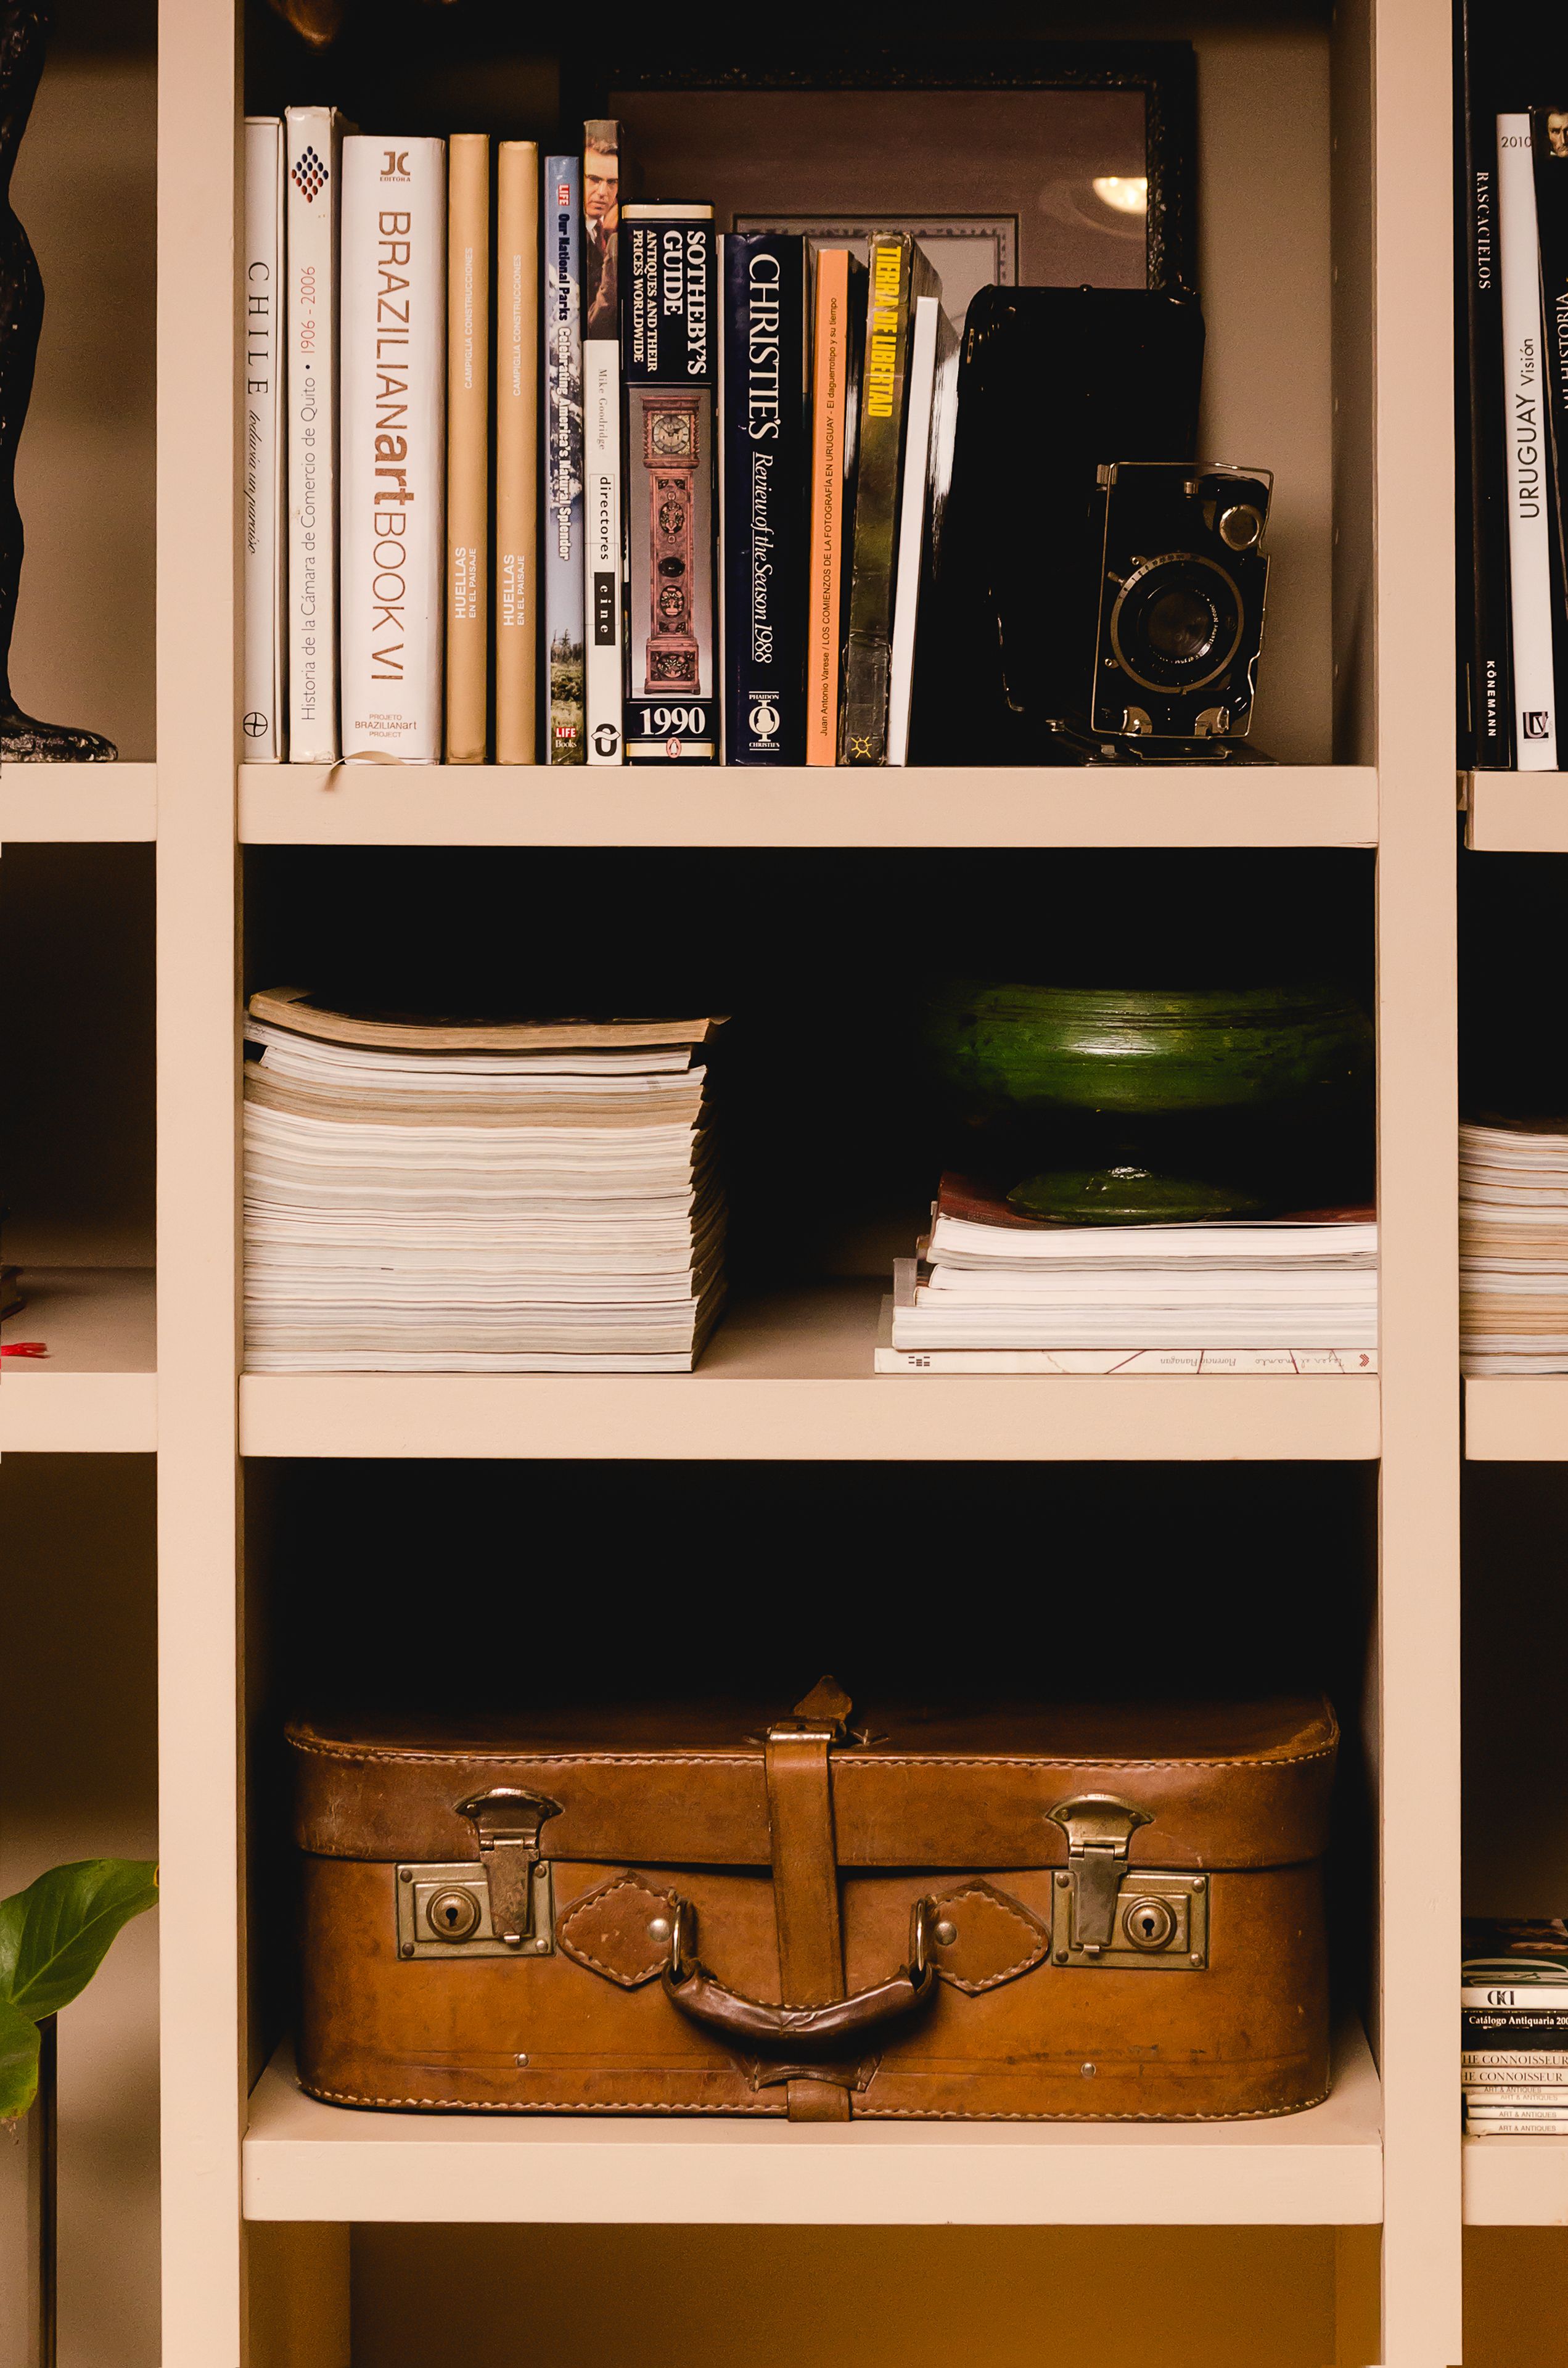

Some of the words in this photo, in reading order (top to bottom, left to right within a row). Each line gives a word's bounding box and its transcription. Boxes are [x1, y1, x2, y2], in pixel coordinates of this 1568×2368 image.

[1501, 137, 1531, 147] 2010
[559, 185, 570, 206] LIFE
[559, 213, 570, 236] Our
[1477, 172, 1490, 289] RASCACIELOS
[559, 237, 570, 284] National
[633, 230, 642, 276] PRICES
[644, 229, 657, 297] ANTIQUES
[301, 267, 316, 304] 2006
[465, 247, 473, 334] CONSTRUCCIONES
[664, 230, 683, 316] GUIDE
[874, 246, 901, 307] TIERRA
[559, 287, 570, 321] Parks
[633, 279, 642, 362] WORLDWIDE
[647, 298, 658, 329] AND
[687, 231, 706, 374] SOTHEBY'S
[829, 297, 837, 325] tiempo
[248, 262, 269, 395] CHILE
[301, 321, 316, 353] 1906
[830, 327, 836, 337] su
[872, 311, 898, 334] DE
[557, 327, 571, 395] Celebrating
[647, 329, 658, 372] THEIR
[747, 253, 781, 439] CHRISTIE'S
[1520, 339, 1533, 386] Visión
[598, 369, 607, 393] Mike
[827, 347, 835, 398] daguerrotipo
[868, 335, 897, 417] LIBERTAD
[301, 378, 316, 422] Quito
[827, 400, 835, 408] El
[301, 427, 316, 446] de
[559, 398, 571, 457] America's
[597, 398, 608, 450] Goodridge
[826, 417, 834, 461] URUGUAY
[826, 464, 833, 476] EN
[1517, 393, 1540, 519] URUGUAY
[248, 472, 257, 495] un
[301, 453, 316, 527] Comercio
[559, 460, 571, 504] Natural
[755, 452, 773, 515] Review
[599, 476, 611, 561] directores
[750, 516, 774, 535] of
[824, 479, 833, 538] FOTOGRAFÍA
[301, 532, 316, 551] de
[557, 507, 571, 561] Splendor
[755, 536, 774, 561] the
[824, 540, 832, 551] LA
[824, 554, 831, 566] DE
[301, 557, 316, 615] Cámara
[454, 547, 466, 619] HUELLAS
[469, 590, 476, 602] EL
[503, 554, 514, 626] HUELLAS
[755, 562, 773, 620] Season
[823, 569, 831, 624] COMIENZOS
[469, 605, 476, 618] EN
[517, 598, 525, 609] EL
[517, 612, 525, 625] EN
[599, 585, 608, 635] cine
[301, 620, 316, 631] la
[755, 623, 773, 664] 1988
[822, 627, 830, 644] LOS
[301, 637, 316, 656] de
[371, 643, 404, 680] VI
[821, 652, 829, 680] Varese
[301, 662, 316, 720] Historia
[821, 683, 829, 714] Antonio
[1487, 661, 1496, 736] KÖNEMANN
[355, 720, 416, 730] BRAZILIANart
[556, 728, 576, 738] LIFE
[639, 707, 705, 735] 1990
[820, 716, 828, 736] Juan
[556, 739, 577, 748] Books
[1160, 1356, 1197, 1367] Flanagan
[1469, 2016, 1506, 2026] Catálogo
[1509, 2016, 1554, 2026] Antiquaria
[1462, 2072, 1476, 2081] HE
[1480, 2072, 1562, 2081] CONNOISSEUR
[1463, 2055, 1479, 2063] HE
[1482, 2055, 1568, 2064] CONNOISSEUR
